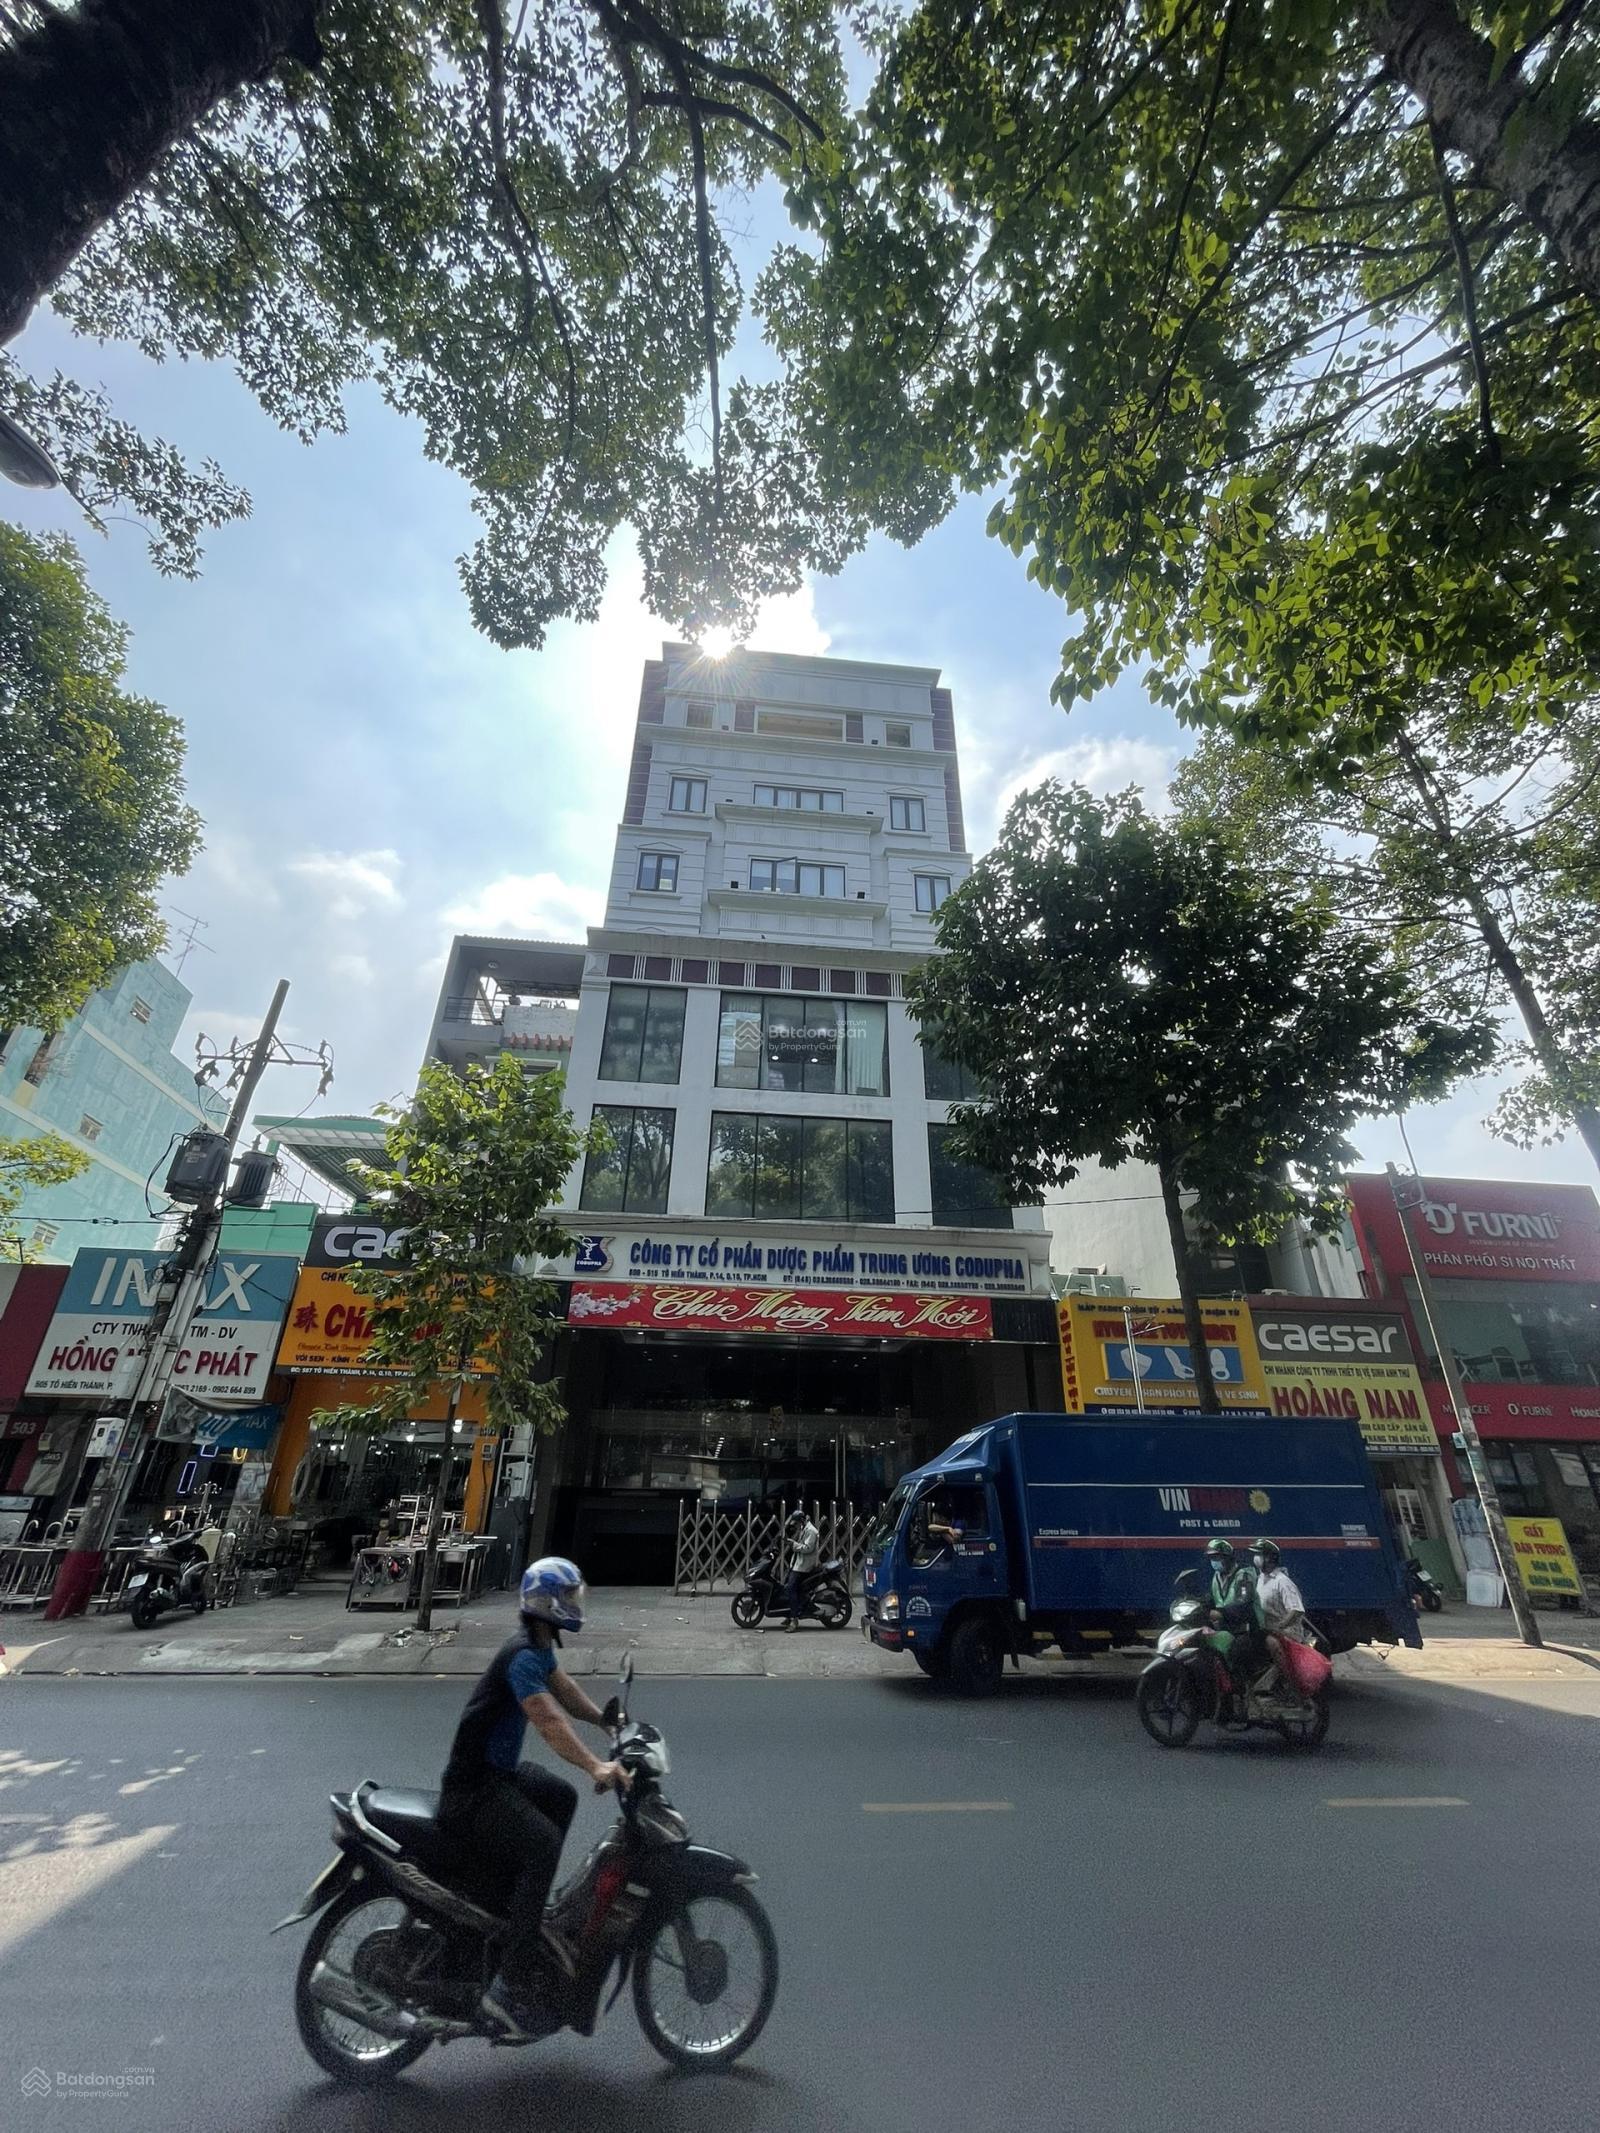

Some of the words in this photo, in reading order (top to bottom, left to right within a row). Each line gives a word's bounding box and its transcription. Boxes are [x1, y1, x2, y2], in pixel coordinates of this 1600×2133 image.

[630, 1238, 672, 1265] CÔNG
[675, 1244, 695, 1266] TY
[698, 1237, 720, 1267] CỔ
[767, 1246, 807, 1275] DƯỢC
[859, 1252, 907, 1275] TRUNG
[912, 1252, 951, 1276] ƯƠNG
[955, 1255, 1024, 1280] CODUPHA
[652, 1289, 740, 1320] Chúc
[721, 1292, 835, 1330] Mừng
[834, 1295, 906, 1323] Năm
[894, 1297, 988, 1330] Mới
[92, 1322, 117, 1335] CTY
[191, 1325, 208, 1338] TM
[218, 1327, 238, 1339] DV
[48, 1335, 117, 1372] HỒNG
[194, 1345, 258, 1377] PHÁT
[1271, 1378, 1361, 1418] HOÀNG
[1364, 1389, 1421, 1420] NAM
[11, 1422, 37, 1435] 503
[1159, 1487, 1192, 1511] VIN
[1180, 1519, 1201, 1528] POST
[1203, 1520, 1211, 1528] &
[1212, 1519, 1241, 1528] CARGO
